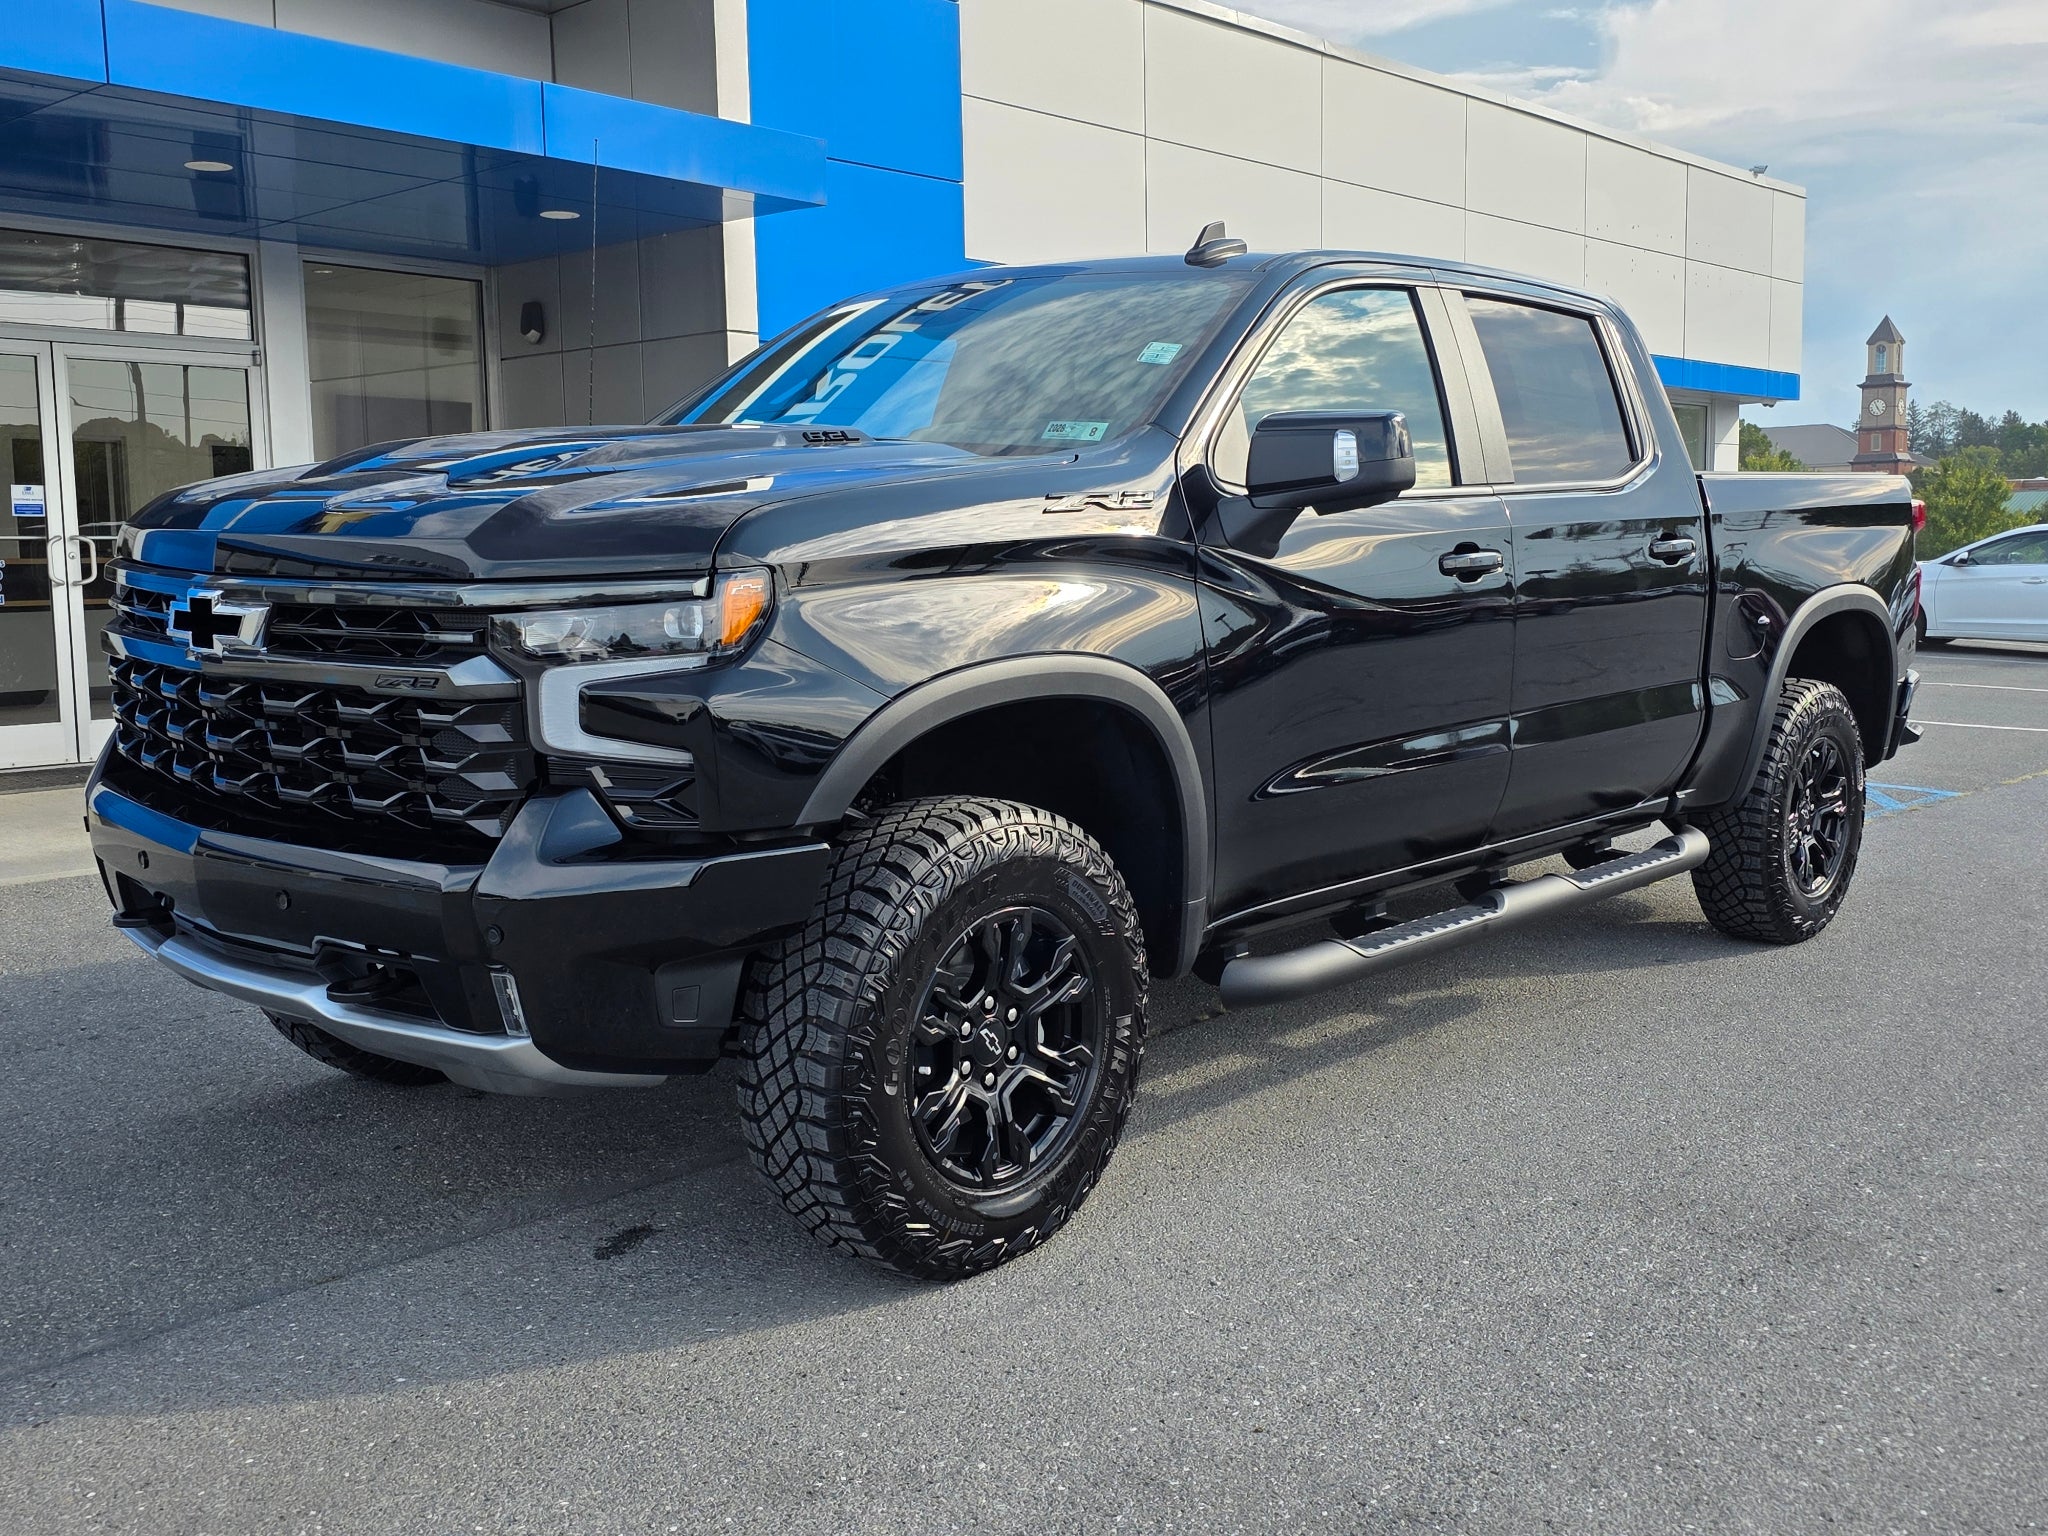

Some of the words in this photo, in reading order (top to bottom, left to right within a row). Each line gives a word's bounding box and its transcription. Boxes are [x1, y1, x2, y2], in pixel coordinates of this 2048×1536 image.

[1088, 426, 1098, 437] 8
[1042, 489, 1155, 514] ZR2
[374, 673, 440, 691] ZR2
[1038, 1013, 1133, 1207] WRANGLER
[915, 1197, 985, 1237] TERRITORY
